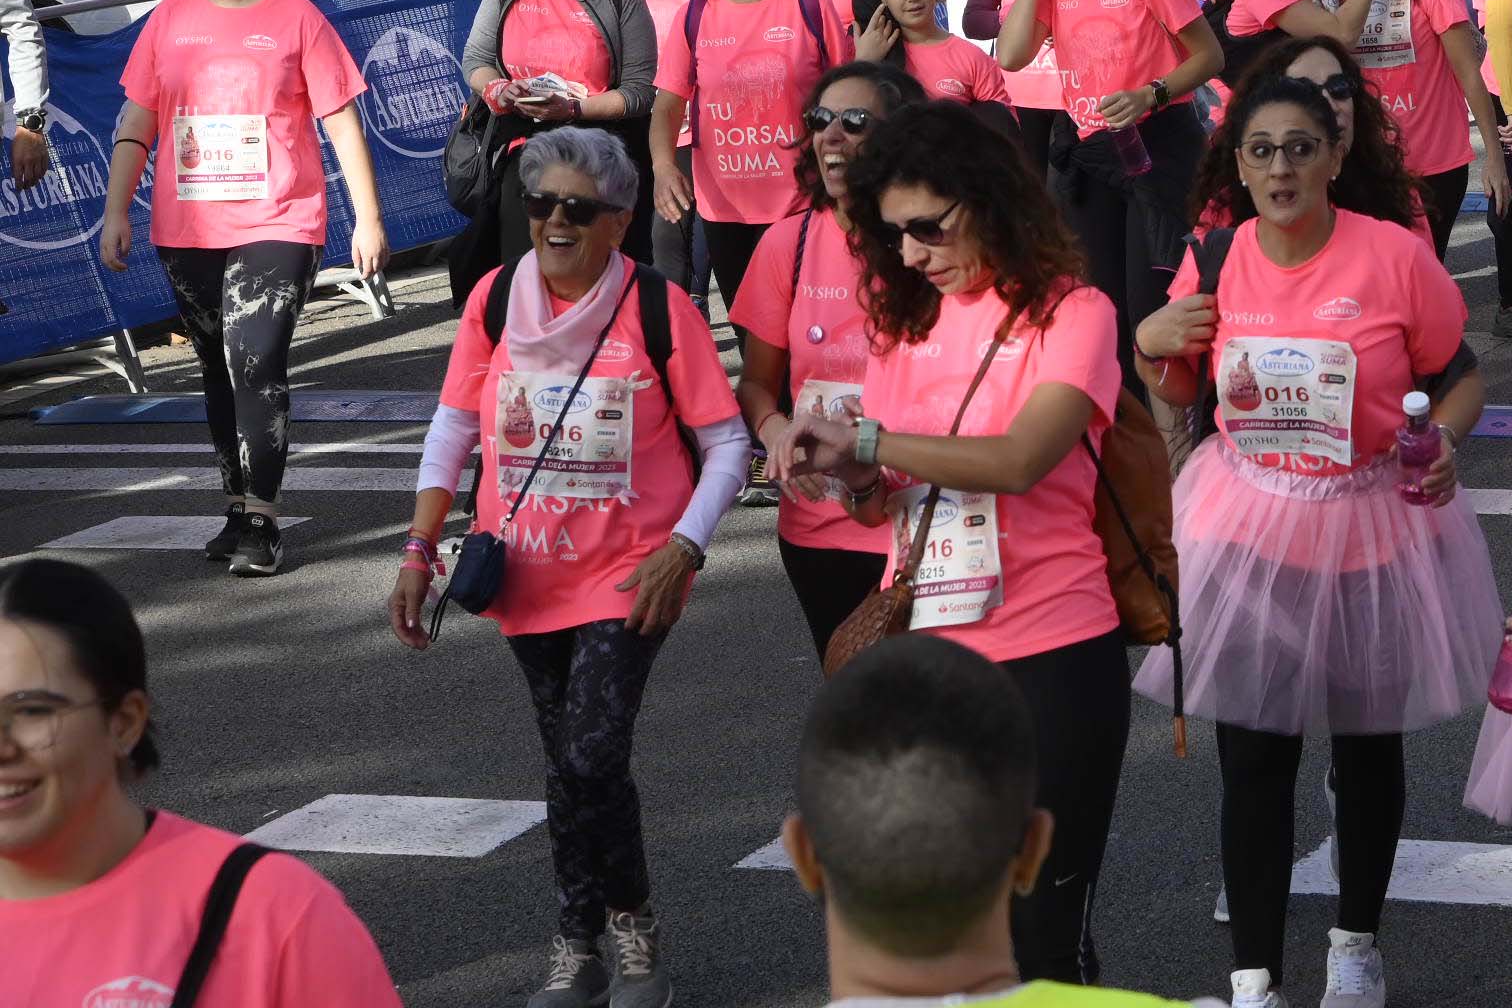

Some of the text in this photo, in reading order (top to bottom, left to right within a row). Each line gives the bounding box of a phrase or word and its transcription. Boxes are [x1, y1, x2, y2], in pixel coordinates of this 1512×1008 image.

[700, 36, 736, 48] OYSHO
[1060, 70, 1081, 89] TU
[706, 102, 733, 121] TU
[203, 149, 233, 161] 016
[717, 151, 781, 172] SUMA
[1221, 311, 1275, 326] OYSHO
[1260, 359, 1310, 371] ASTURIANA
[1264, 386, 1310, 403] 016
[1272, 407, 1308, 417] 31056
[1239, 421, 1276, 429] CARRERA
[1301, 422, 1325, 431] MUJER
[539, 423, 583, 442] 016
[1238, 436, 1279, 446] OYSHO
[569, 463, 596, 471] MUJER
[930, 584, 939, 593] LA
[940, 581, 966, 592] MUJER
[948, 600, 986, 613] Santand
